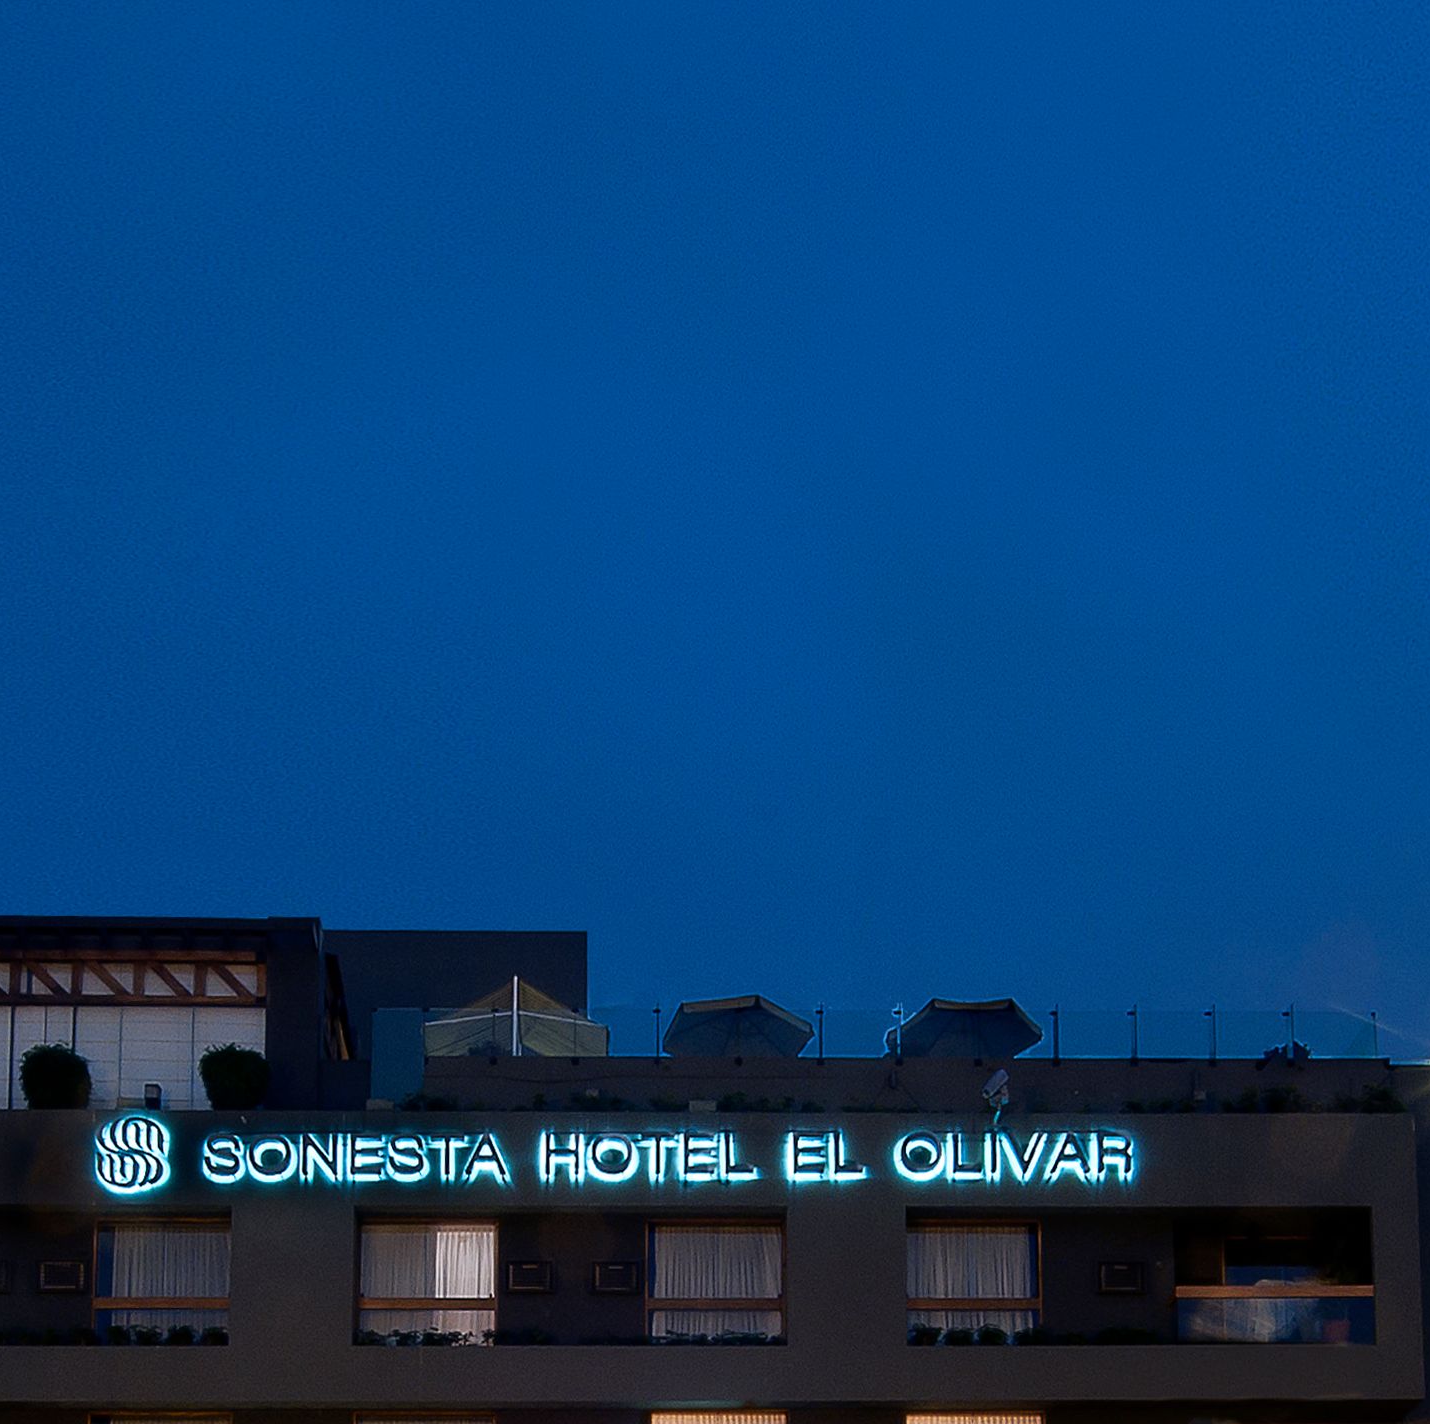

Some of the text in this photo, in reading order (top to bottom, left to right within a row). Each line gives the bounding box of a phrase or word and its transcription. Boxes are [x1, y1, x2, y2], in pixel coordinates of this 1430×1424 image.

[202, 1131, 511, 1184] SONESTA
[537, 1130, 760, 1184] HOTEL
[782, 1130, 867, 1184] EL
[892, 1130, 1136, 1184] OLIVAR
